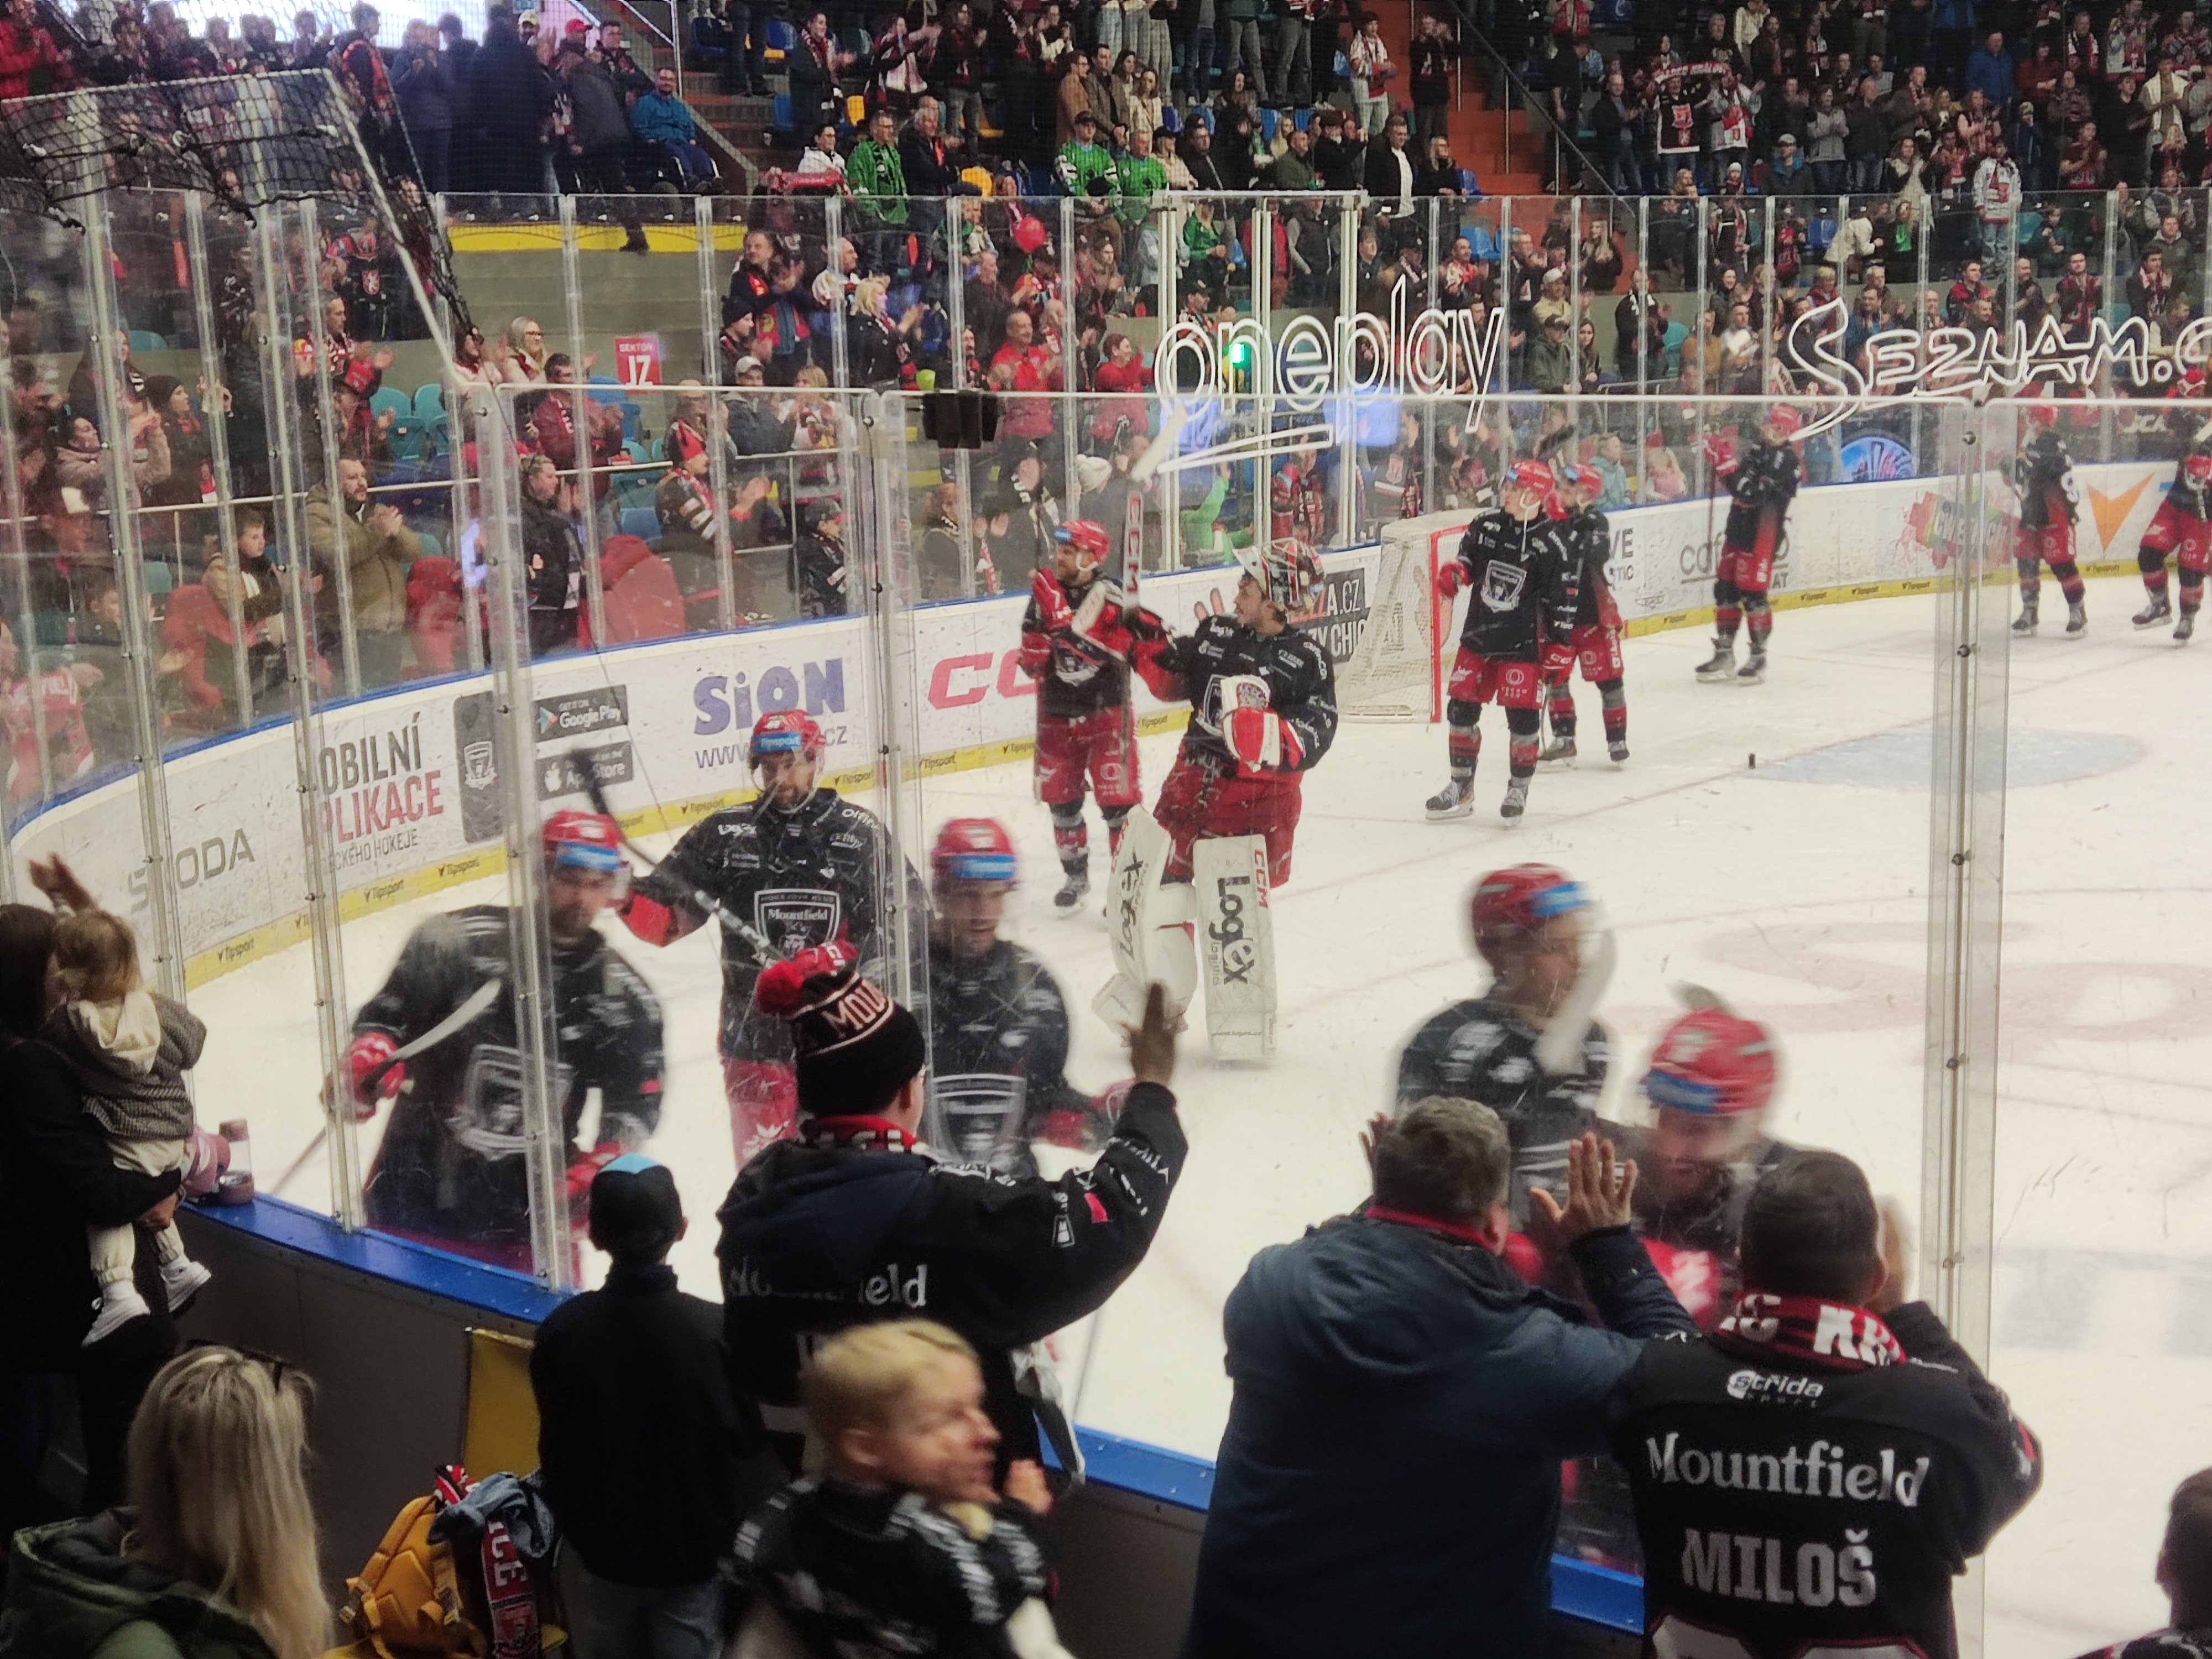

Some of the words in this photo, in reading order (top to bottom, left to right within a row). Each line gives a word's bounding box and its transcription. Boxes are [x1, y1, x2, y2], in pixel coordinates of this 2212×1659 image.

[1155, 274, 1504, 445] oneplay
[928, 652, 1037, 709] CC
[560, 711, 599, 728] Google
[599, 705, 621, 722] Play
[319, 711, 421, 795] OBILNÍ
[924, 750, 957, 770] Tipsport
[374, 828, 418, 857] HOKEJE
[446, 858, 480, 877] Tipsport
[1254, 849, 1269, 909] CCM
[372, 879, 404, 901] Tipsport
[768, 909, 828, 921] Mountfield
[225, 938, 255, 962] Tipsport
[1646, 1431, 1931, 1507] Mountfield
[1681, 1527, 1876, 1608] MILOŠ
